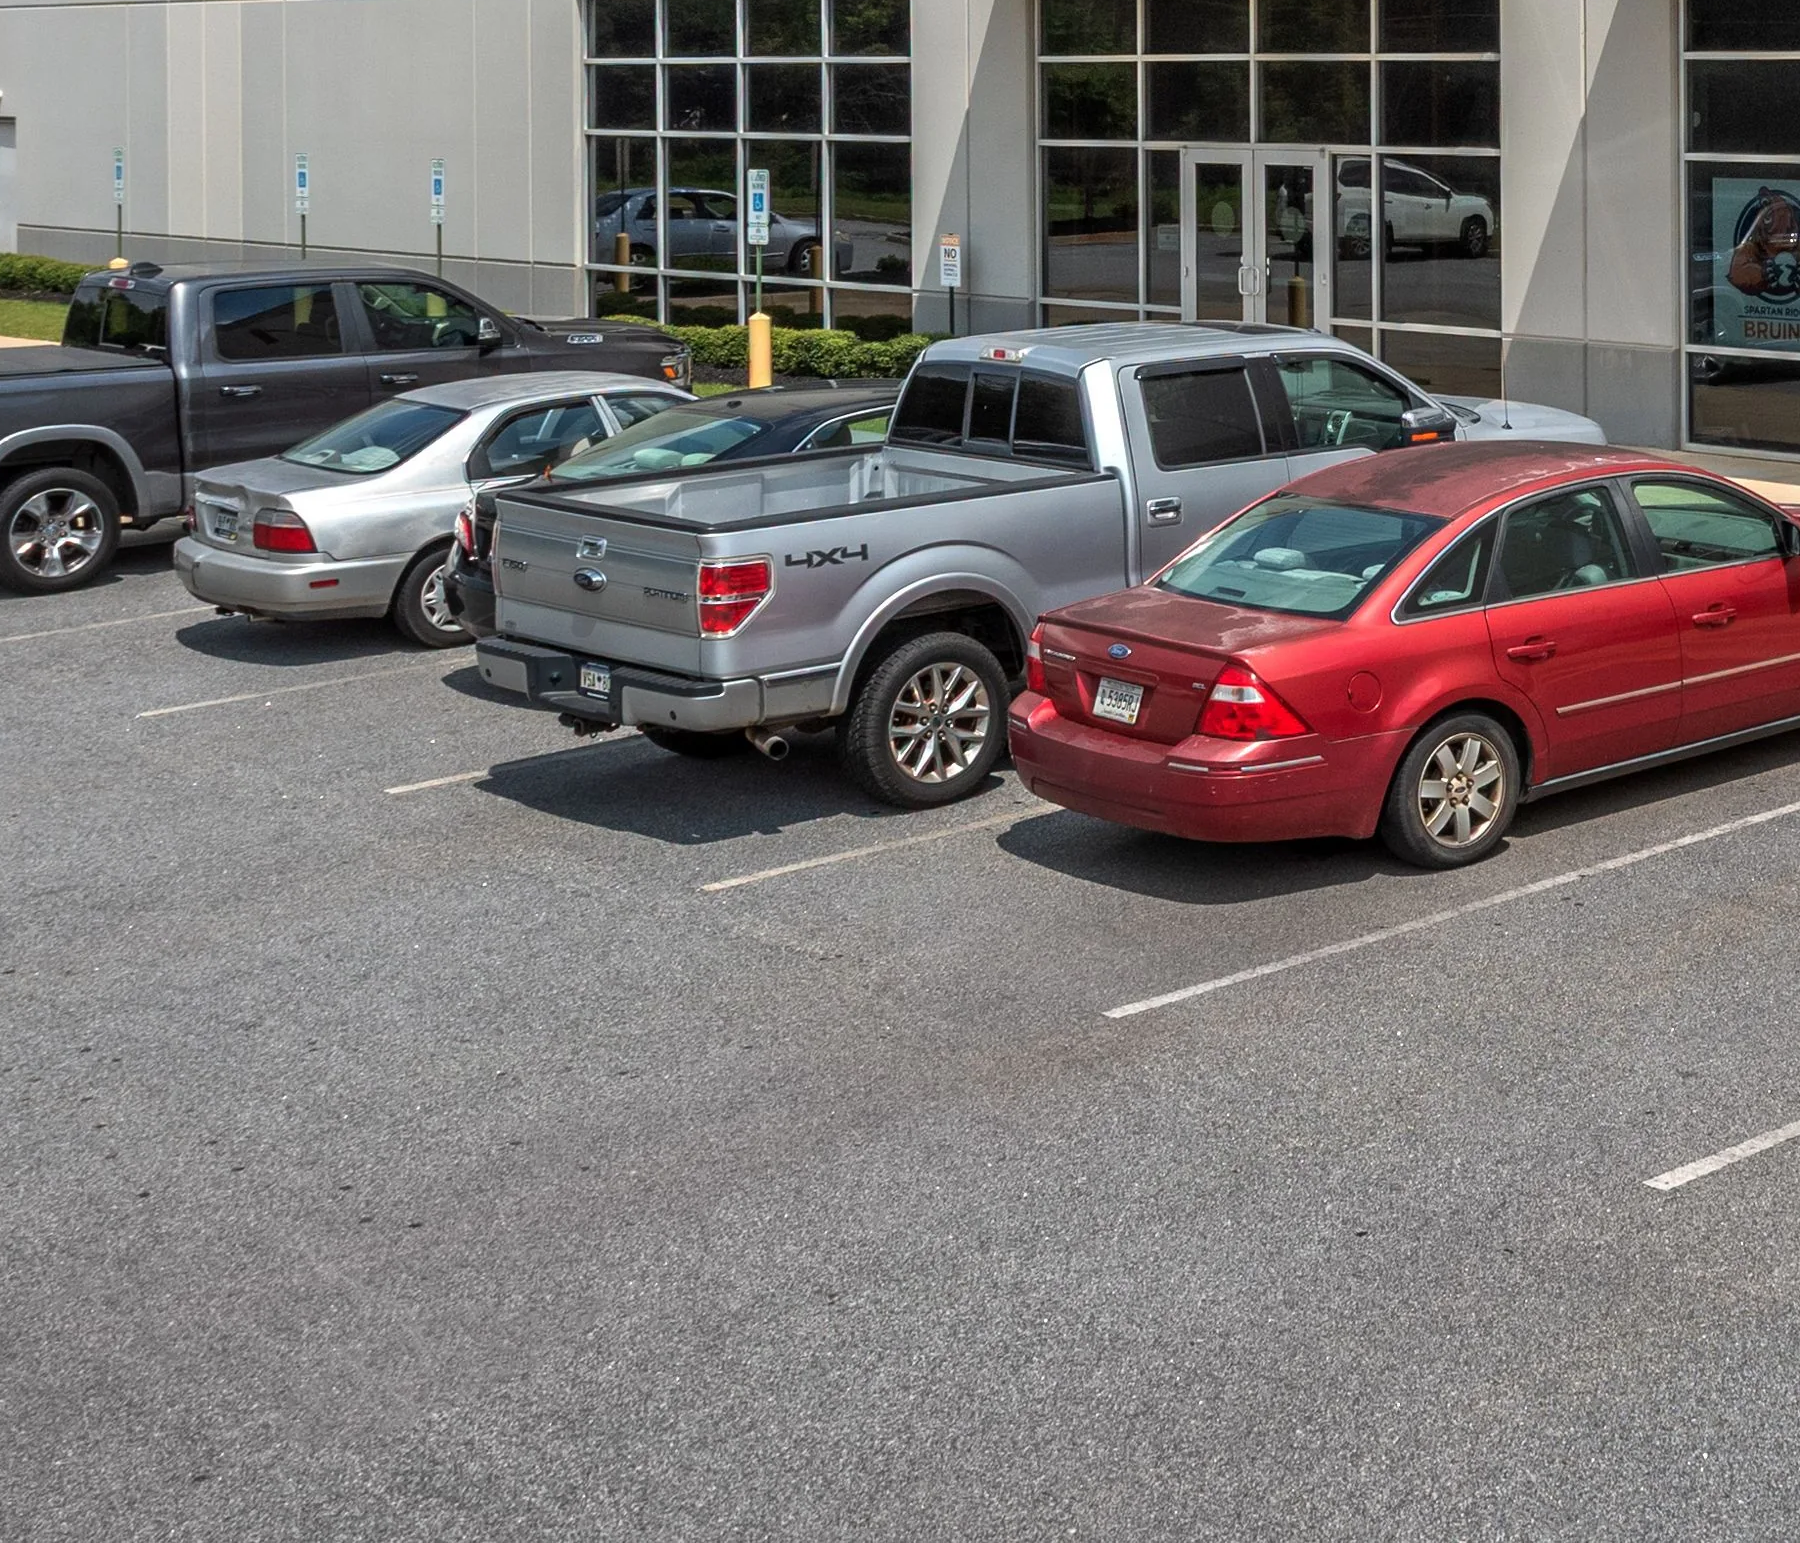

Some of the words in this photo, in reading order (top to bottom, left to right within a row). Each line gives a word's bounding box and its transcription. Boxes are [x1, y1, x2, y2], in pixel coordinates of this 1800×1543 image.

[944, 248, 957, 258] NO
[1744, 306, 1783, 317] SPARTAN
[784, 543, 869, 569] 4X4
